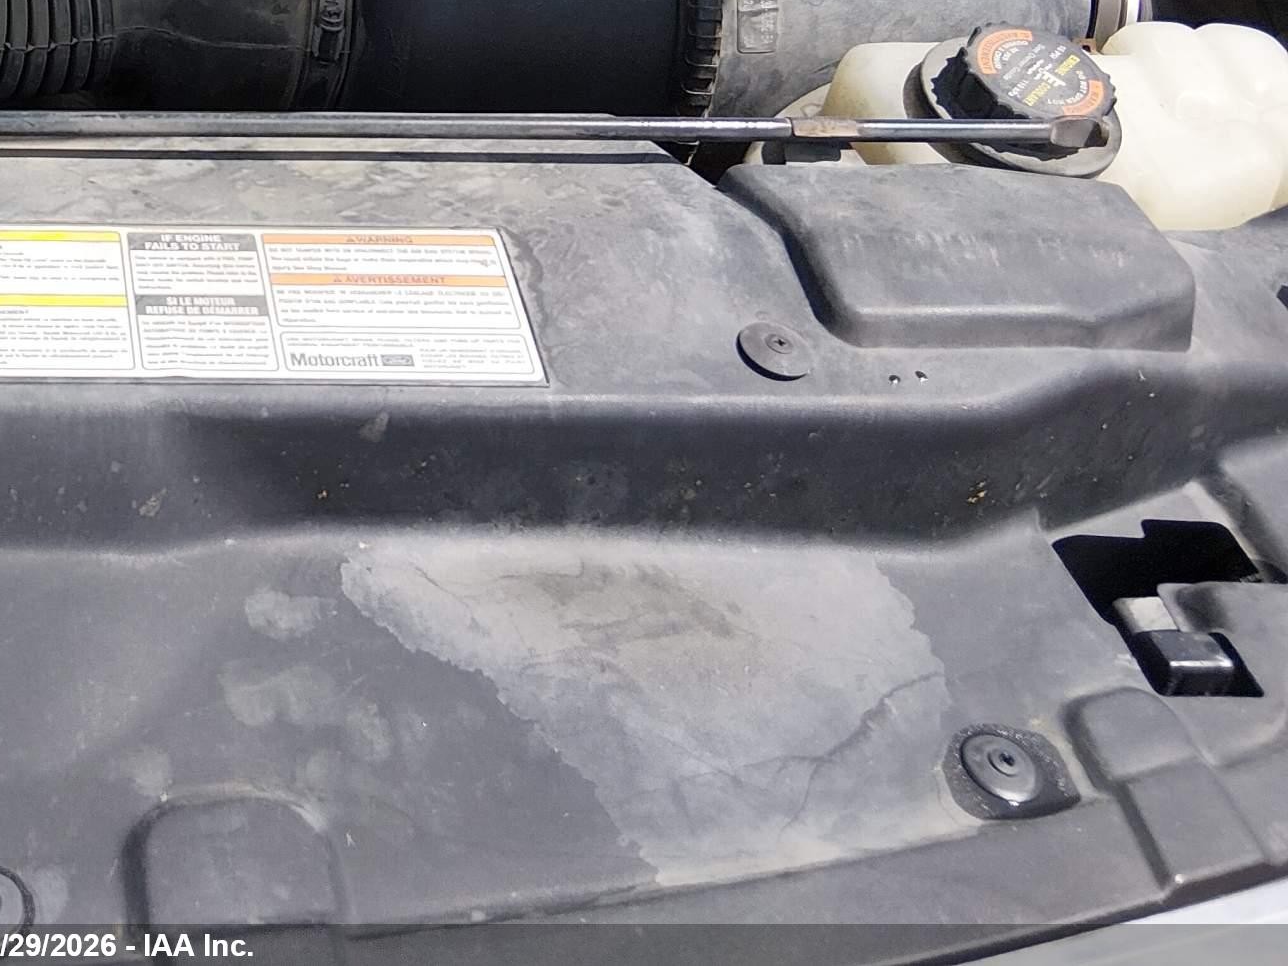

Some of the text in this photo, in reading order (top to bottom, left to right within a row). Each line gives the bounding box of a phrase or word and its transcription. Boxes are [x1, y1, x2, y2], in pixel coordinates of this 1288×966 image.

[160, 234, 222, 242] IF ENGINE
[355, 235, 413, 243] WARNING
[143, 242, 241, 251] FAILS TO START
[344, 275, 446, 285] AVERTISSEMENT
[166, 297, 236, 306] SI LE MOTEUR
[145, 305, 185, 314] REFUSE
[186, 306, 201, 314] DE
[290, 353, 379, 367] Motorcraft
